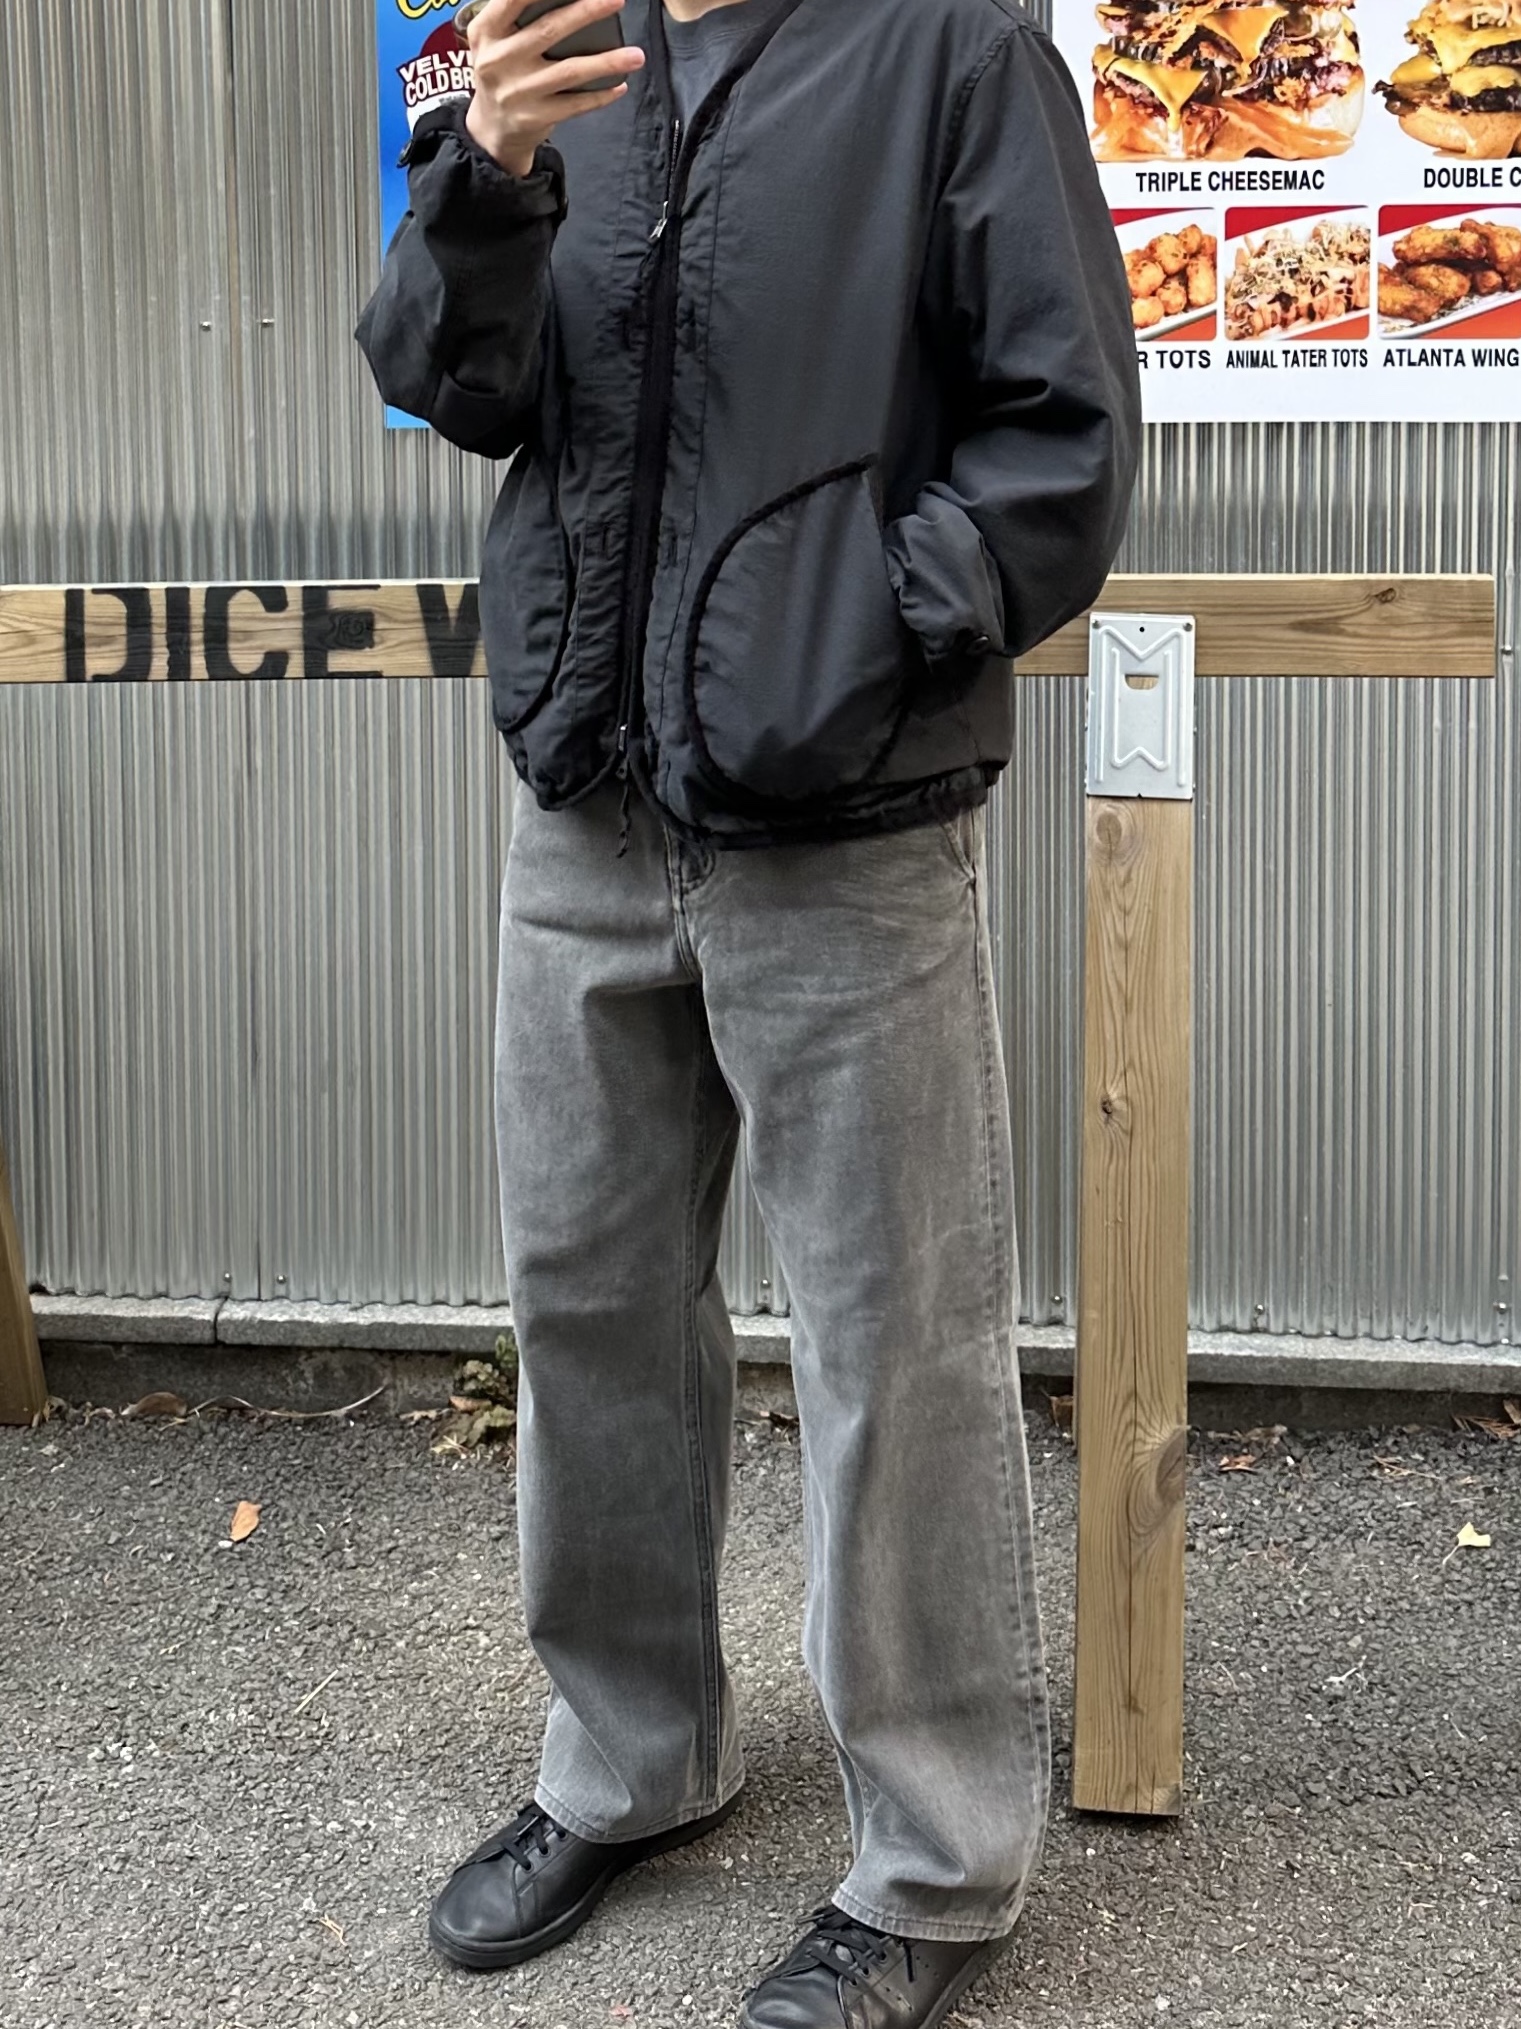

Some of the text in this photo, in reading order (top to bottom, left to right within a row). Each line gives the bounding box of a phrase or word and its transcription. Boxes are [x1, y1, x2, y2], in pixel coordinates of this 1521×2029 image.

[405, 69, 449, 105] COLD
[1136, 169, 1325, 192] TRIPLE CHEESEMAC
[1423, 166, 1521, 188] DOUBLE C
[1155, 349, 1211, 368] TOTS
[1226, 348, 1368, 368] ANIMAL TATER TOTS
[1383, 348, 1519, 367] ATLANTA WING
[65, 585, 383, 681] DICE
